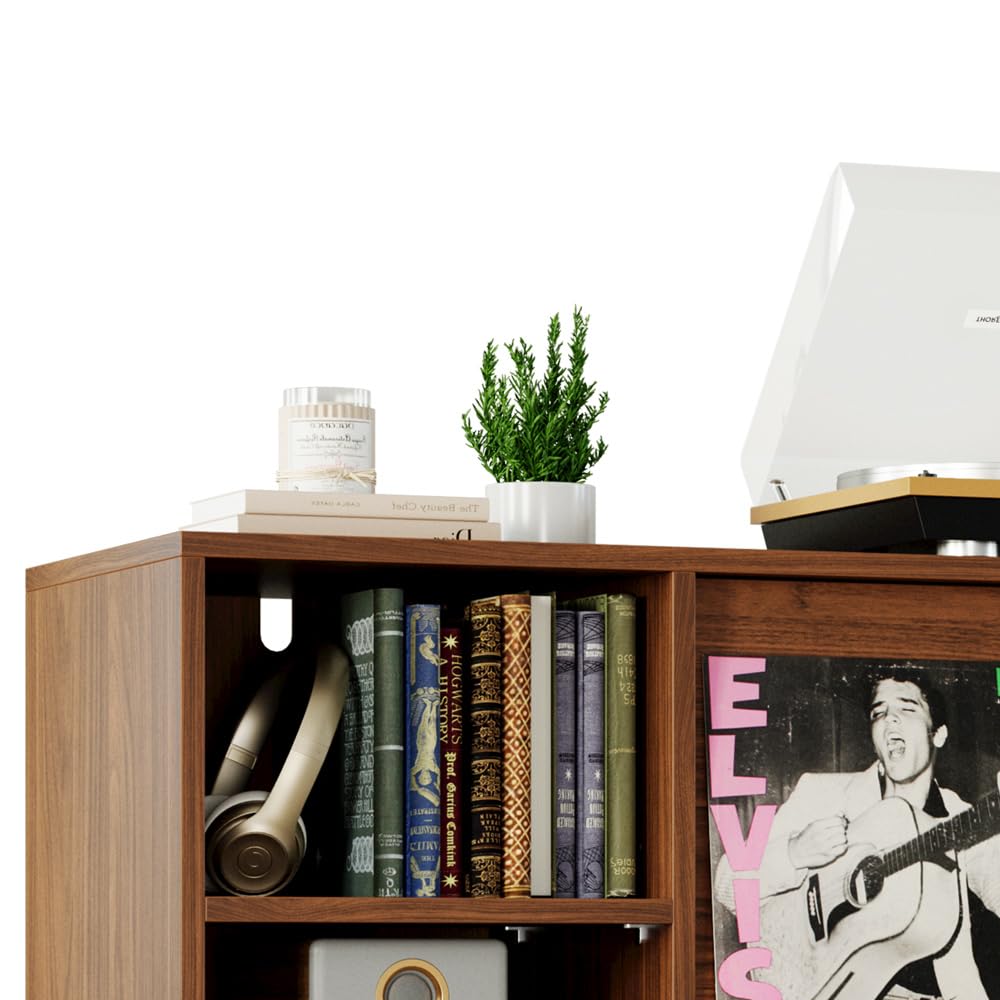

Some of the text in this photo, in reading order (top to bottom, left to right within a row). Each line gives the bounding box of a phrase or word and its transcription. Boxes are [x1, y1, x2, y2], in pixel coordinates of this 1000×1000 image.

[440, 675, 449, 744] HISTORY
[451, 654, 463, 745] HOGWARTS
[444, 751, 457, 780] Prof.
